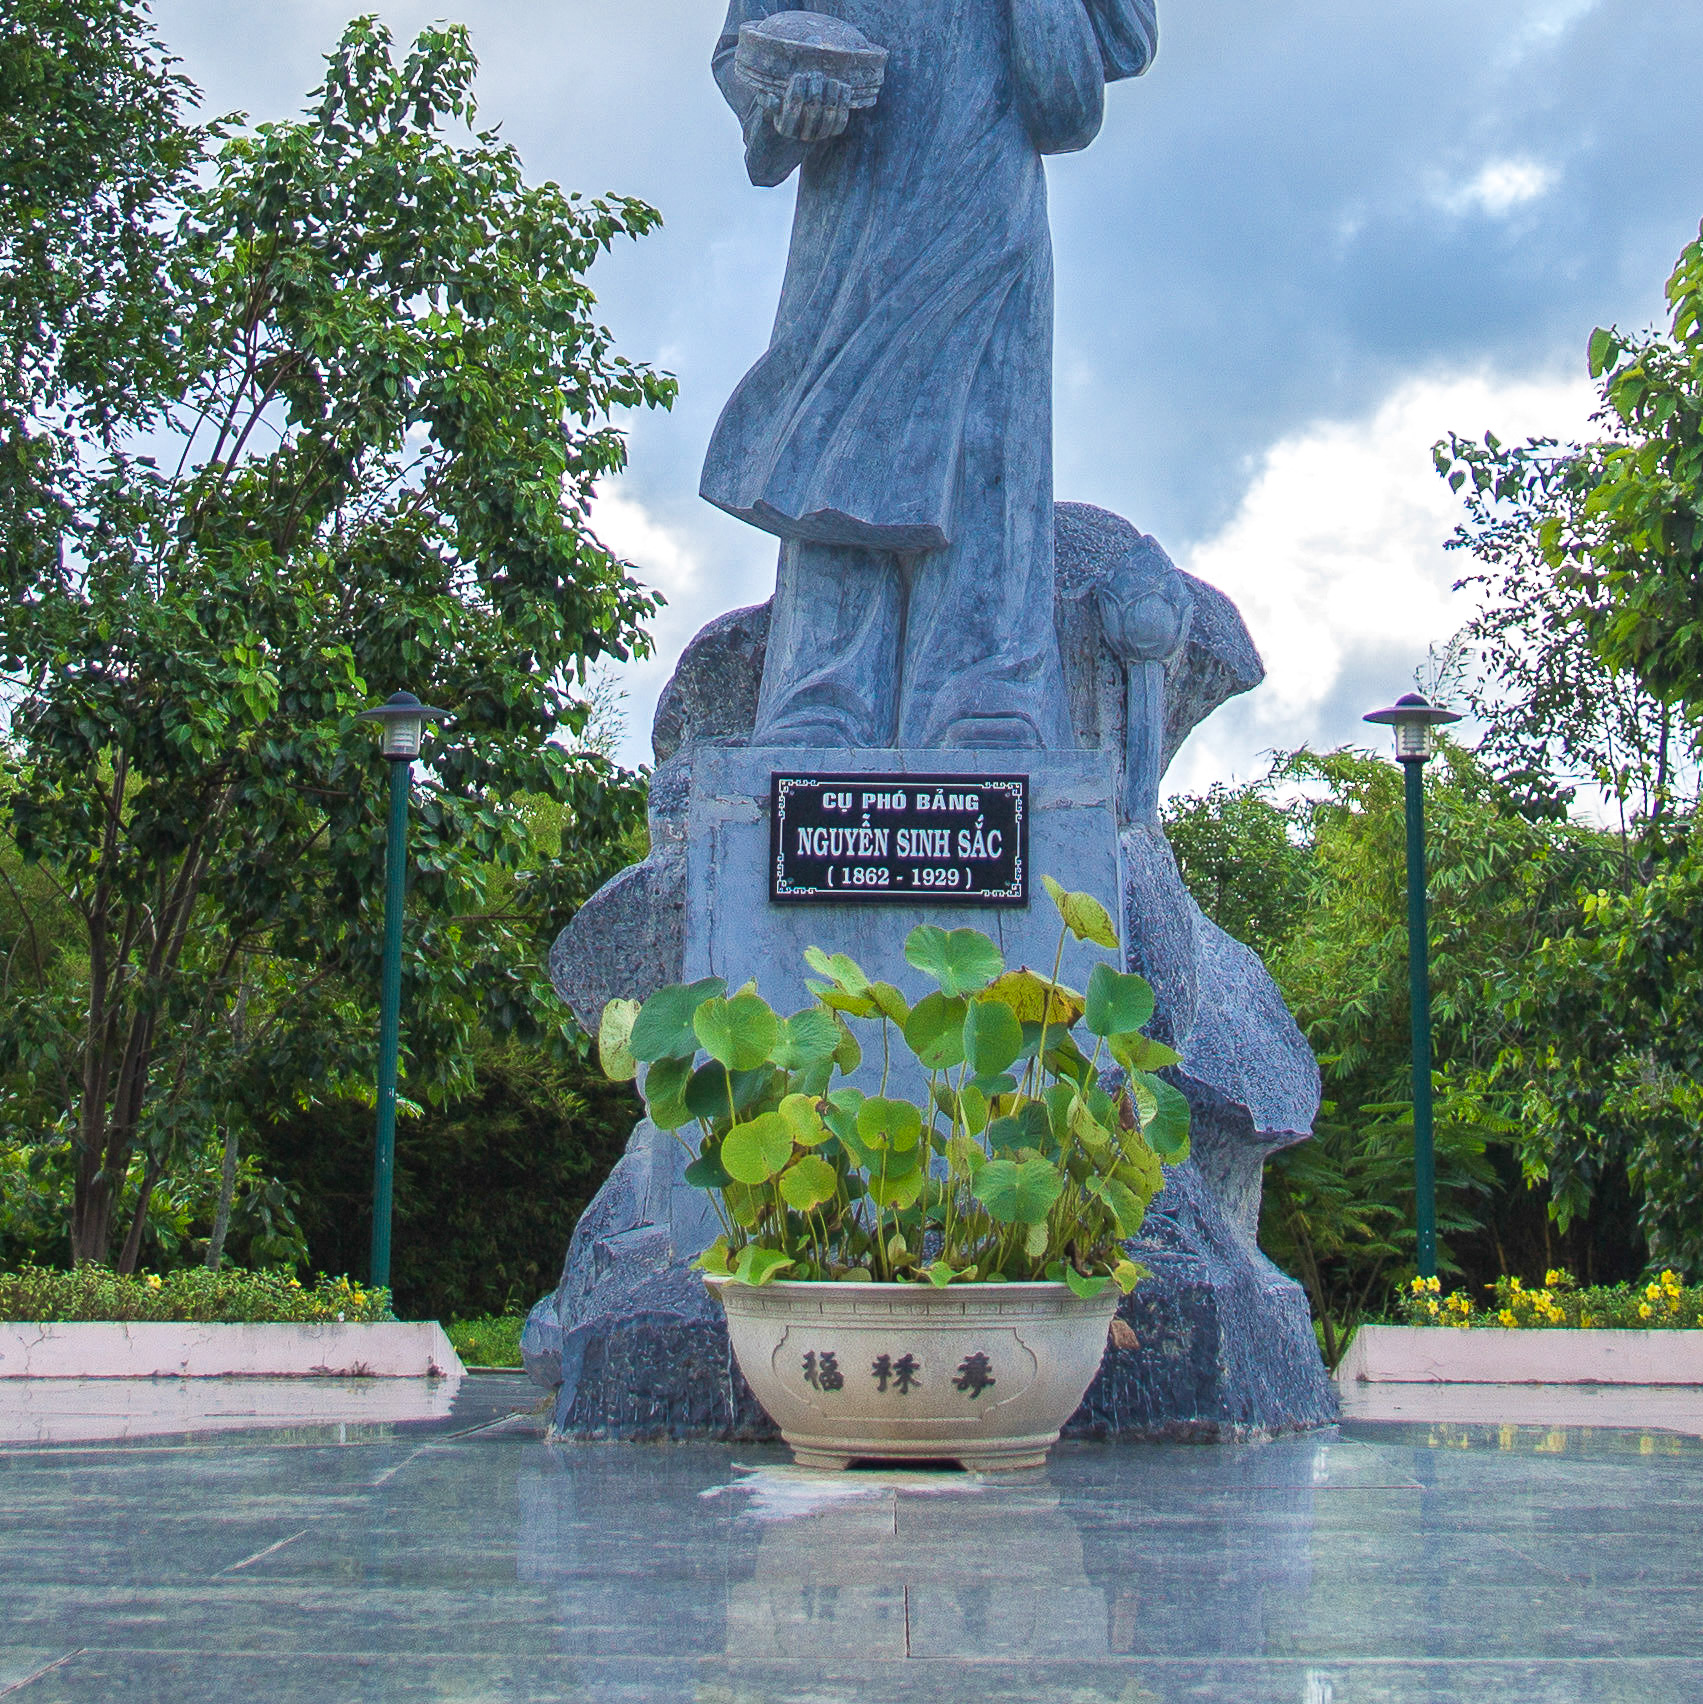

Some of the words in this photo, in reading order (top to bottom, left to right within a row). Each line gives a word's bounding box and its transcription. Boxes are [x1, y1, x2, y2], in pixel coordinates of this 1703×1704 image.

[822, 792, 853, 813] CỤ
[861, 789, 907, 810] PHÓ
[916, 787, 979, 811] BẢNG
[796, 812, 890, 857] NGUYỄN
[896, 827, 951, 858] SINH
[957, 813, 1003, 859] SẮC
